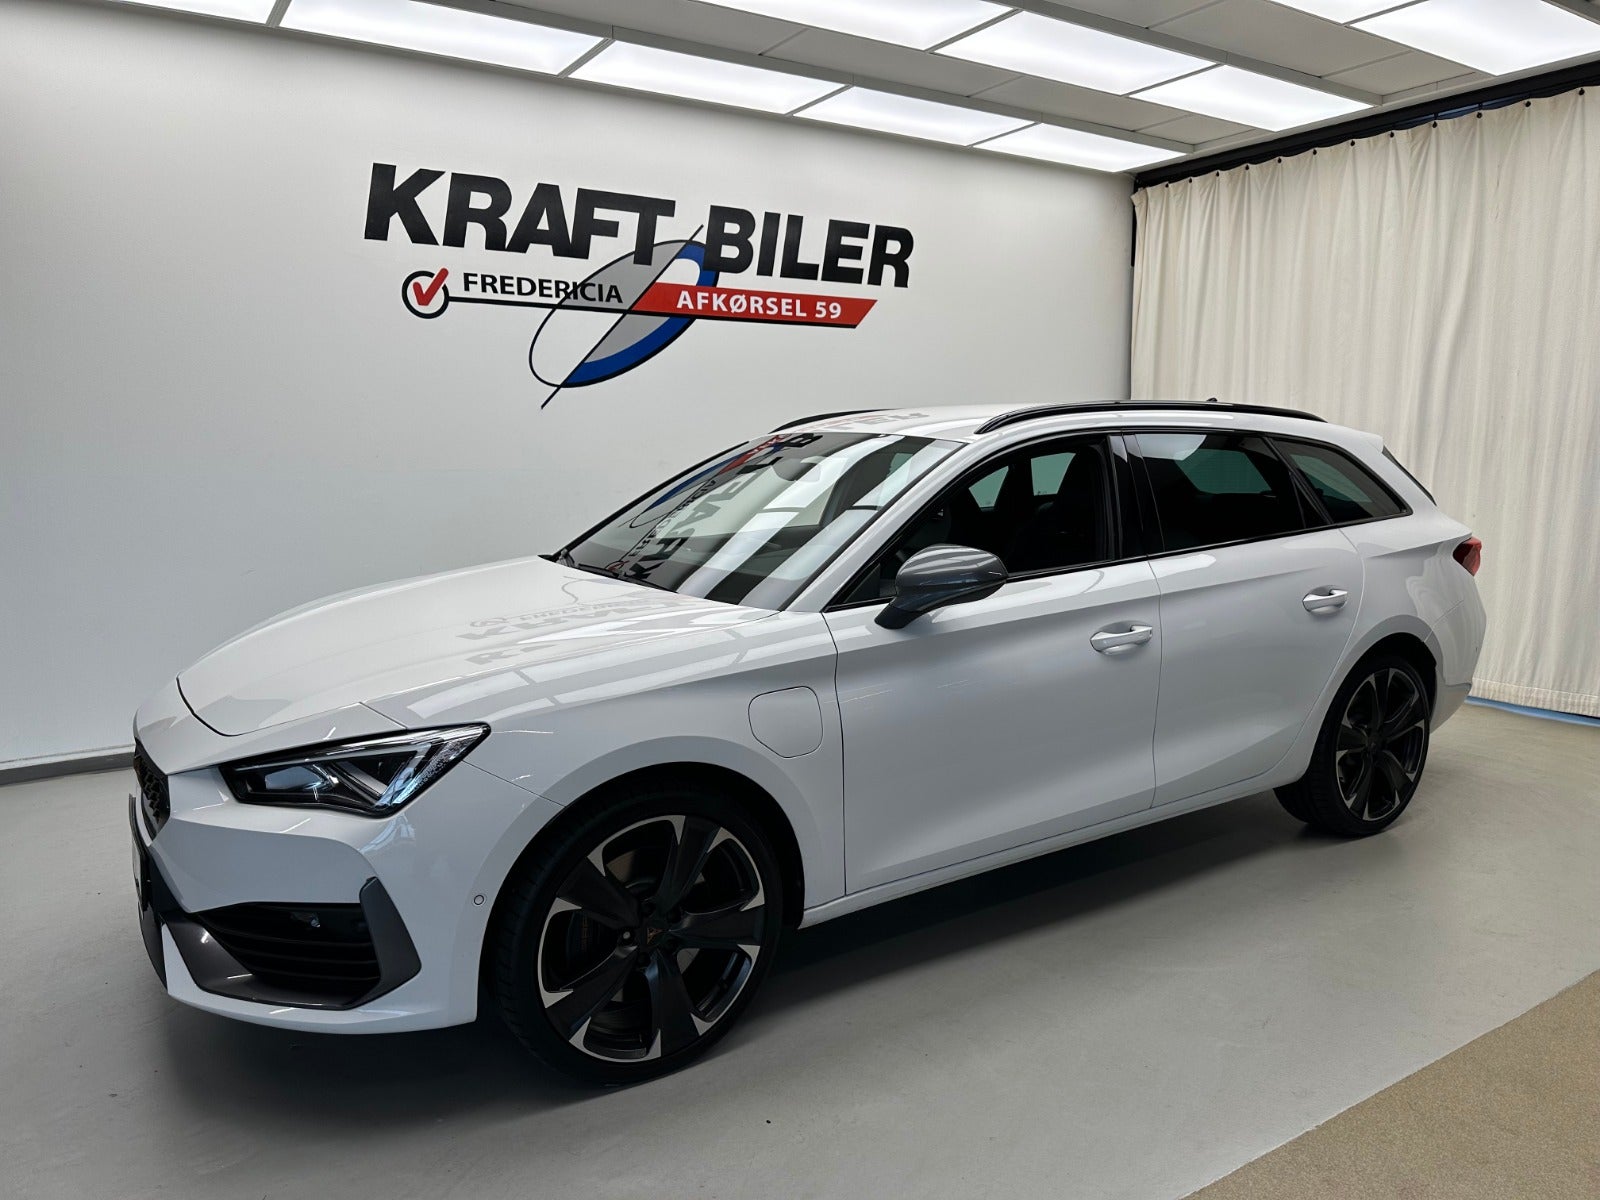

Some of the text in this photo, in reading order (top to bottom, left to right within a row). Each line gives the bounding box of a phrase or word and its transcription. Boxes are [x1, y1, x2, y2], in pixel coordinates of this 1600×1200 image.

[364, 162, 914, 288] KRAFT BILER
[463, 272, 624, 304] FREDERICIA
[676, 290, 842, 319] AFKØRSEL 59
